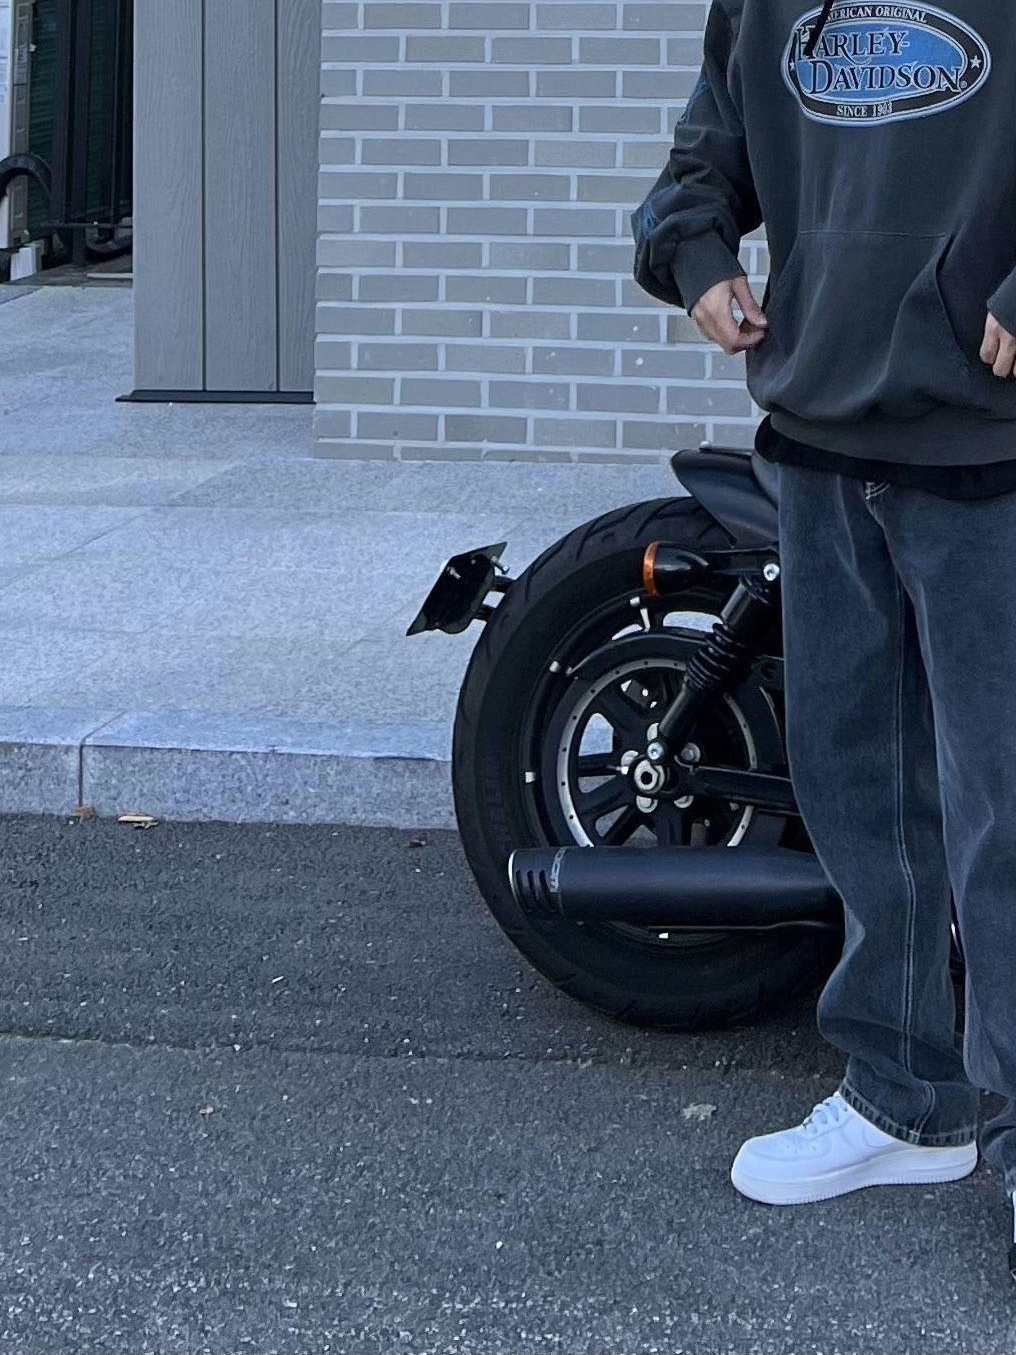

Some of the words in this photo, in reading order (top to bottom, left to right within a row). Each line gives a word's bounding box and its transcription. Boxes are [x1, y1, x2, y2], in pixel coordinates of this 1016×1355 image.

[827, 6, 872, 22] MERICAN
[875, 5, 927, 24] ORIGINAL
[809, 59, 963, 95] DAVIDSON
[836, 104, 867, 117] SINCE
